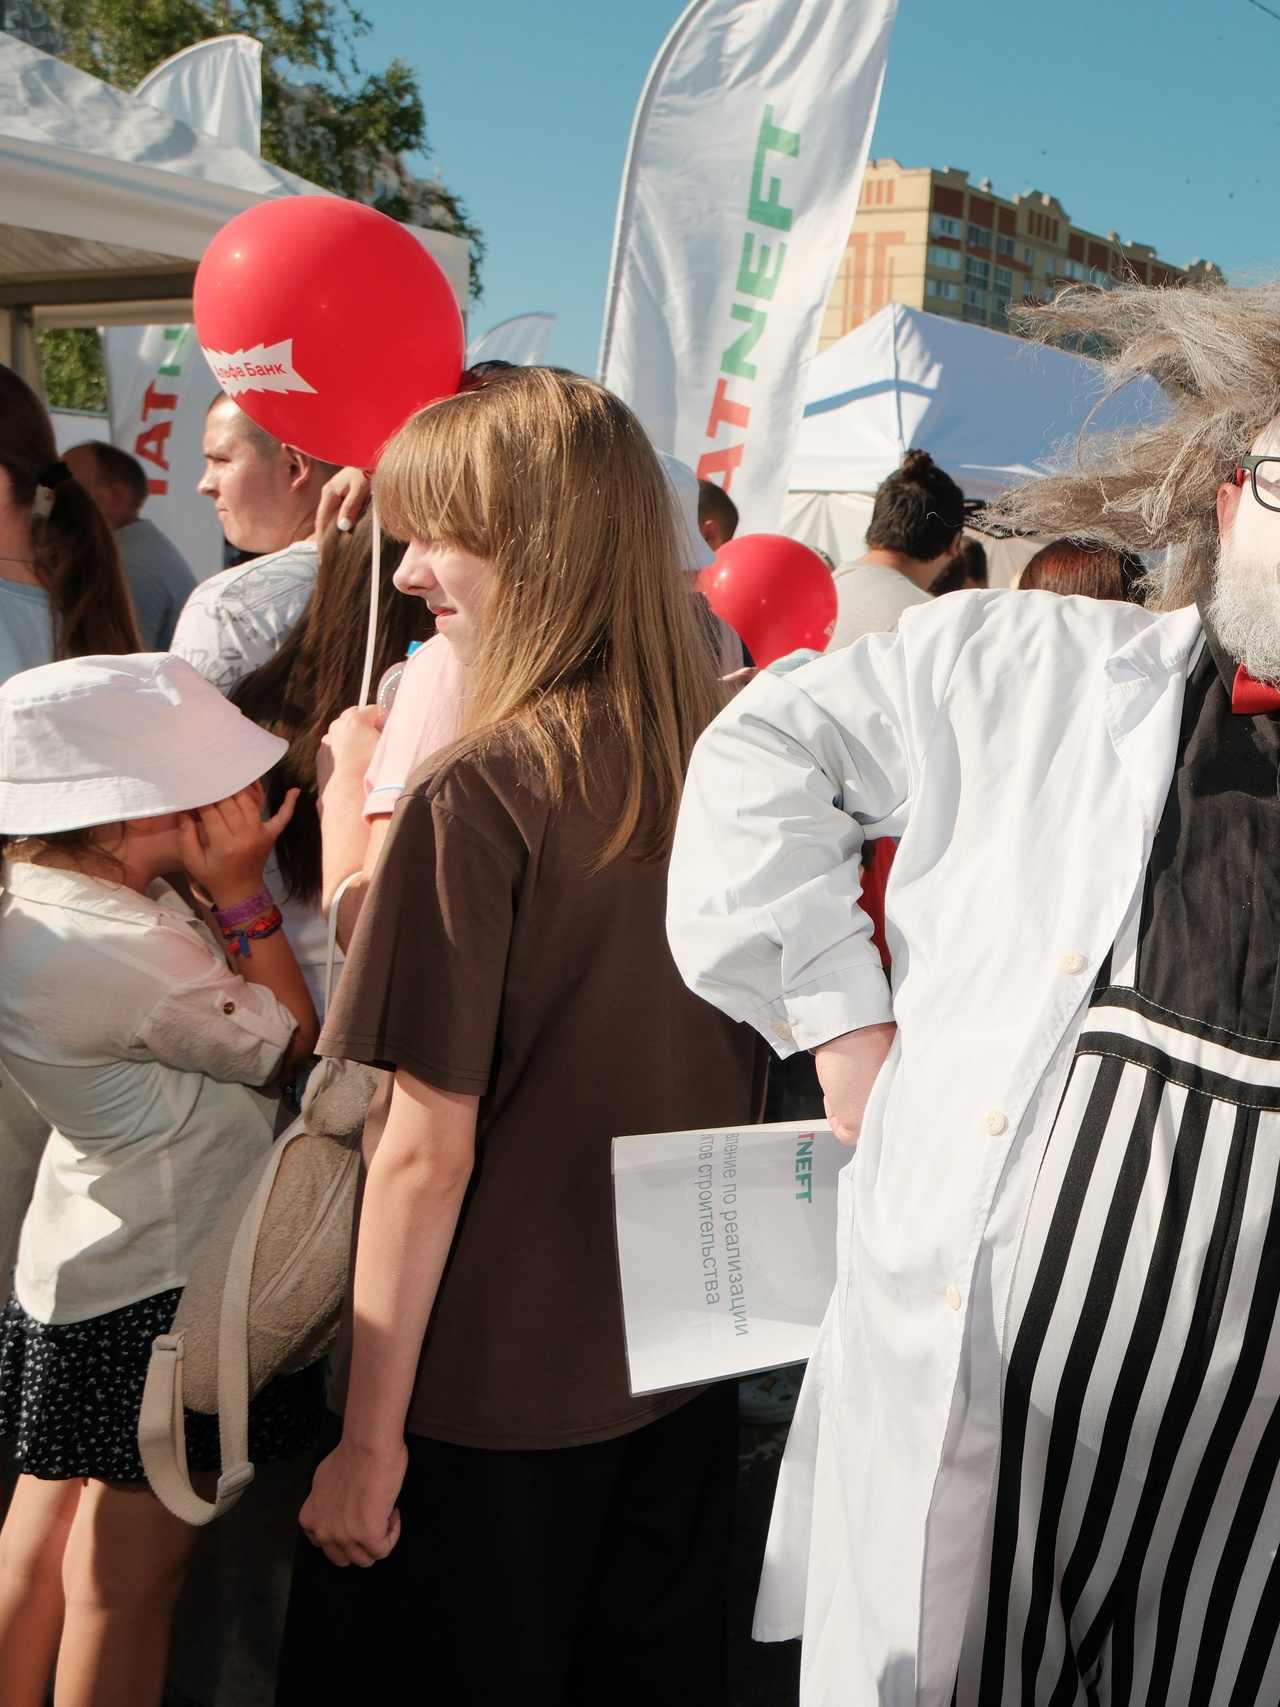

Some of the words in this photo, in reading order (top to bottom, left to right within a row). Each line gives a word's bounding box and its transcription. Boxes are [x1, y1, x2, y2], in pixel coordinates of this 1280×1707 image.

[243, 362, 287, 377] Банк
[722, 1183, 737, 1204] по
[694, 1164, 720, 1305] строительства
[719, 1209, 748, 1336] реализации
